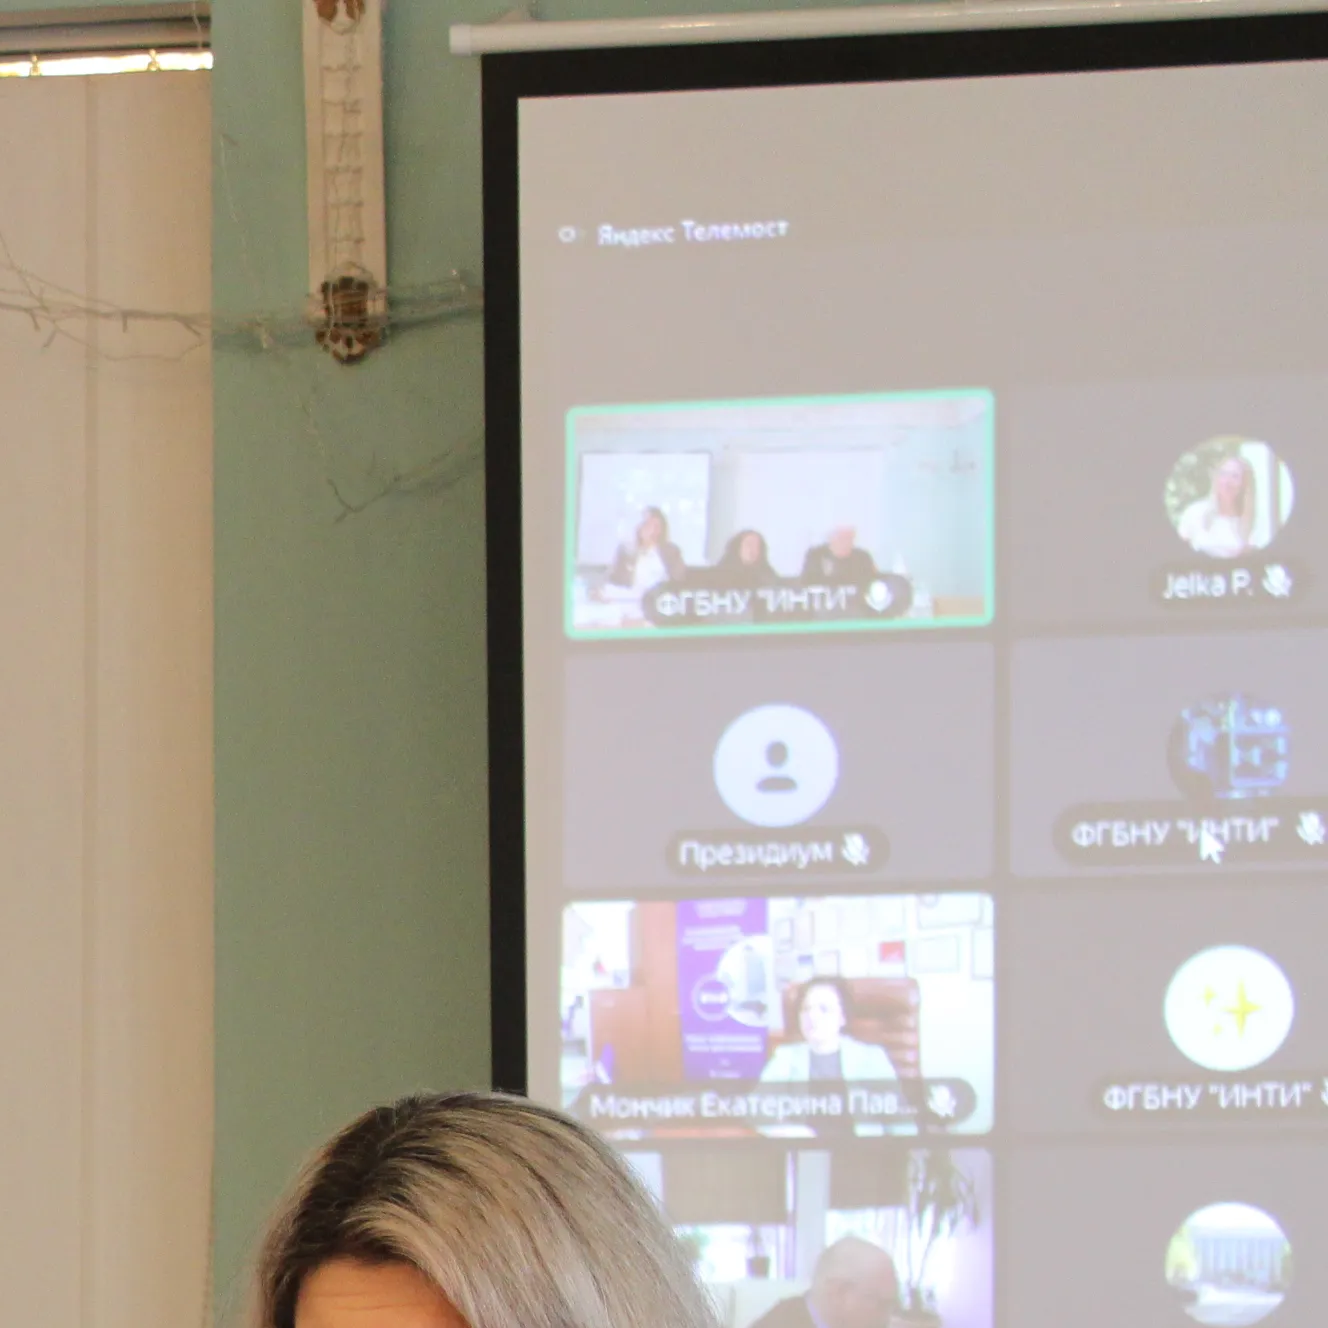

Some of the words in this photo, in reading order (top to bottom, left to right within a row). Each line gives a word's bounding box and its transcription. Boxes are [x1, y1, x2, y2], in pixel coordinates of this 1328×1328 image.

[598, 223, 674, 248] Яндекс
[682, 218, 789, 242] Телемост
[655, 588, 748, 616] ФГБНУ
[757, 584, 856, 613] "ИНТИ"
[1072, 820, 1169, 847] ФГБНУ
[679, 840, 833, 869] Президиум
[590, 1092, 695, 1119] Мончик
[701, 1090, 843, 1120] Екатерина
[1102, 1084, 1201, 1112] ФГБНУ
[1209, 1082, 1312, 1109] "ИНТИ"
